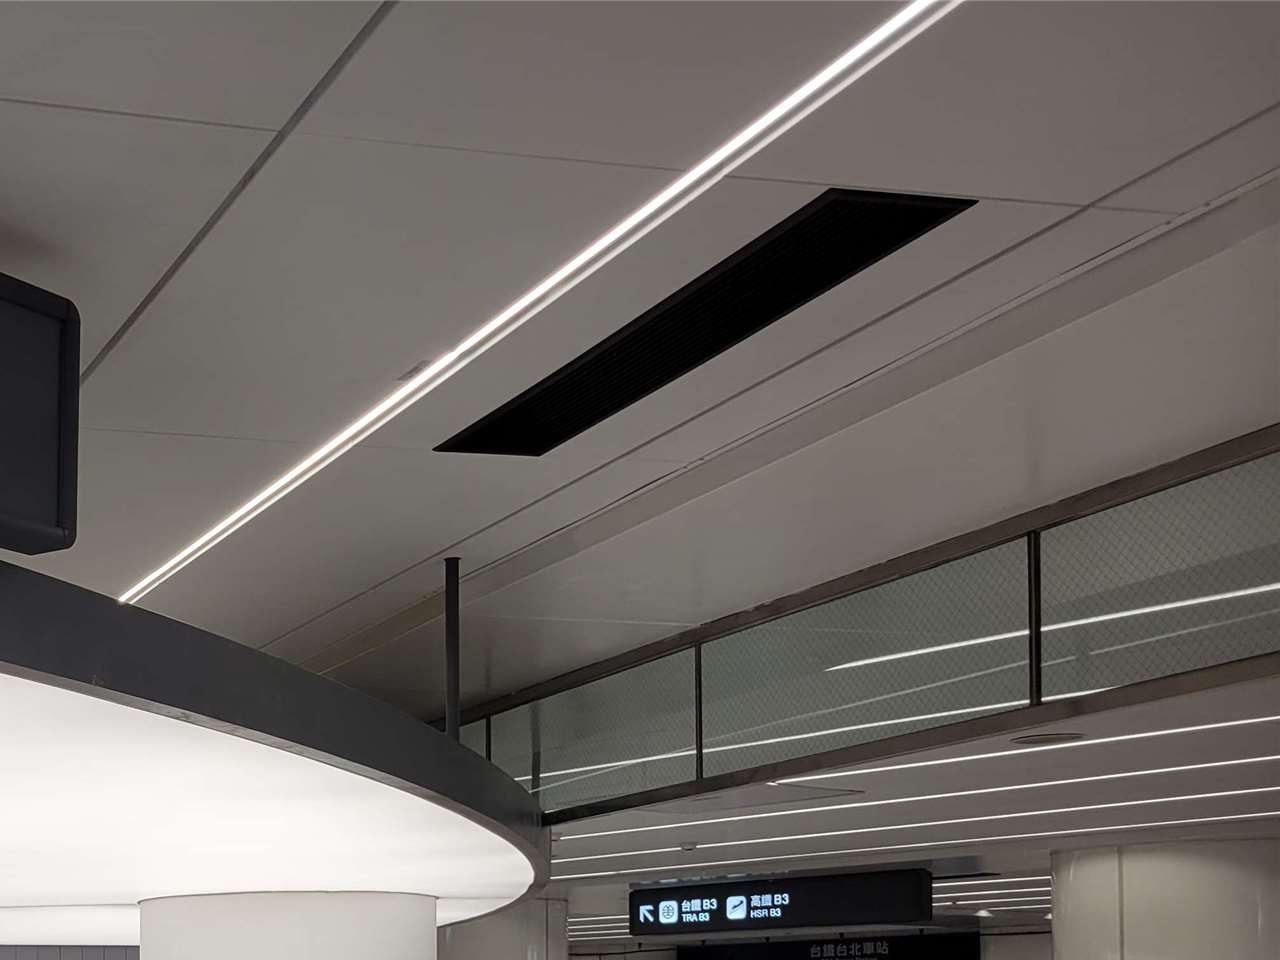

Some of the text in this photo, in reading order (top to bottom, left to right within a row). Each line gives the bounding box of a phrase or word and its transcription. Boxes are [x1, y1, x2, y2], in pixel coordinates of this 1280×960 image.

[681, 899, 717, 912] 台鐵 B3
[750, 893, 789, 907] 高鐵 B3
[681, 912, 710, 922] TRA B3
[750, 908, 781, 919] HSR B3
